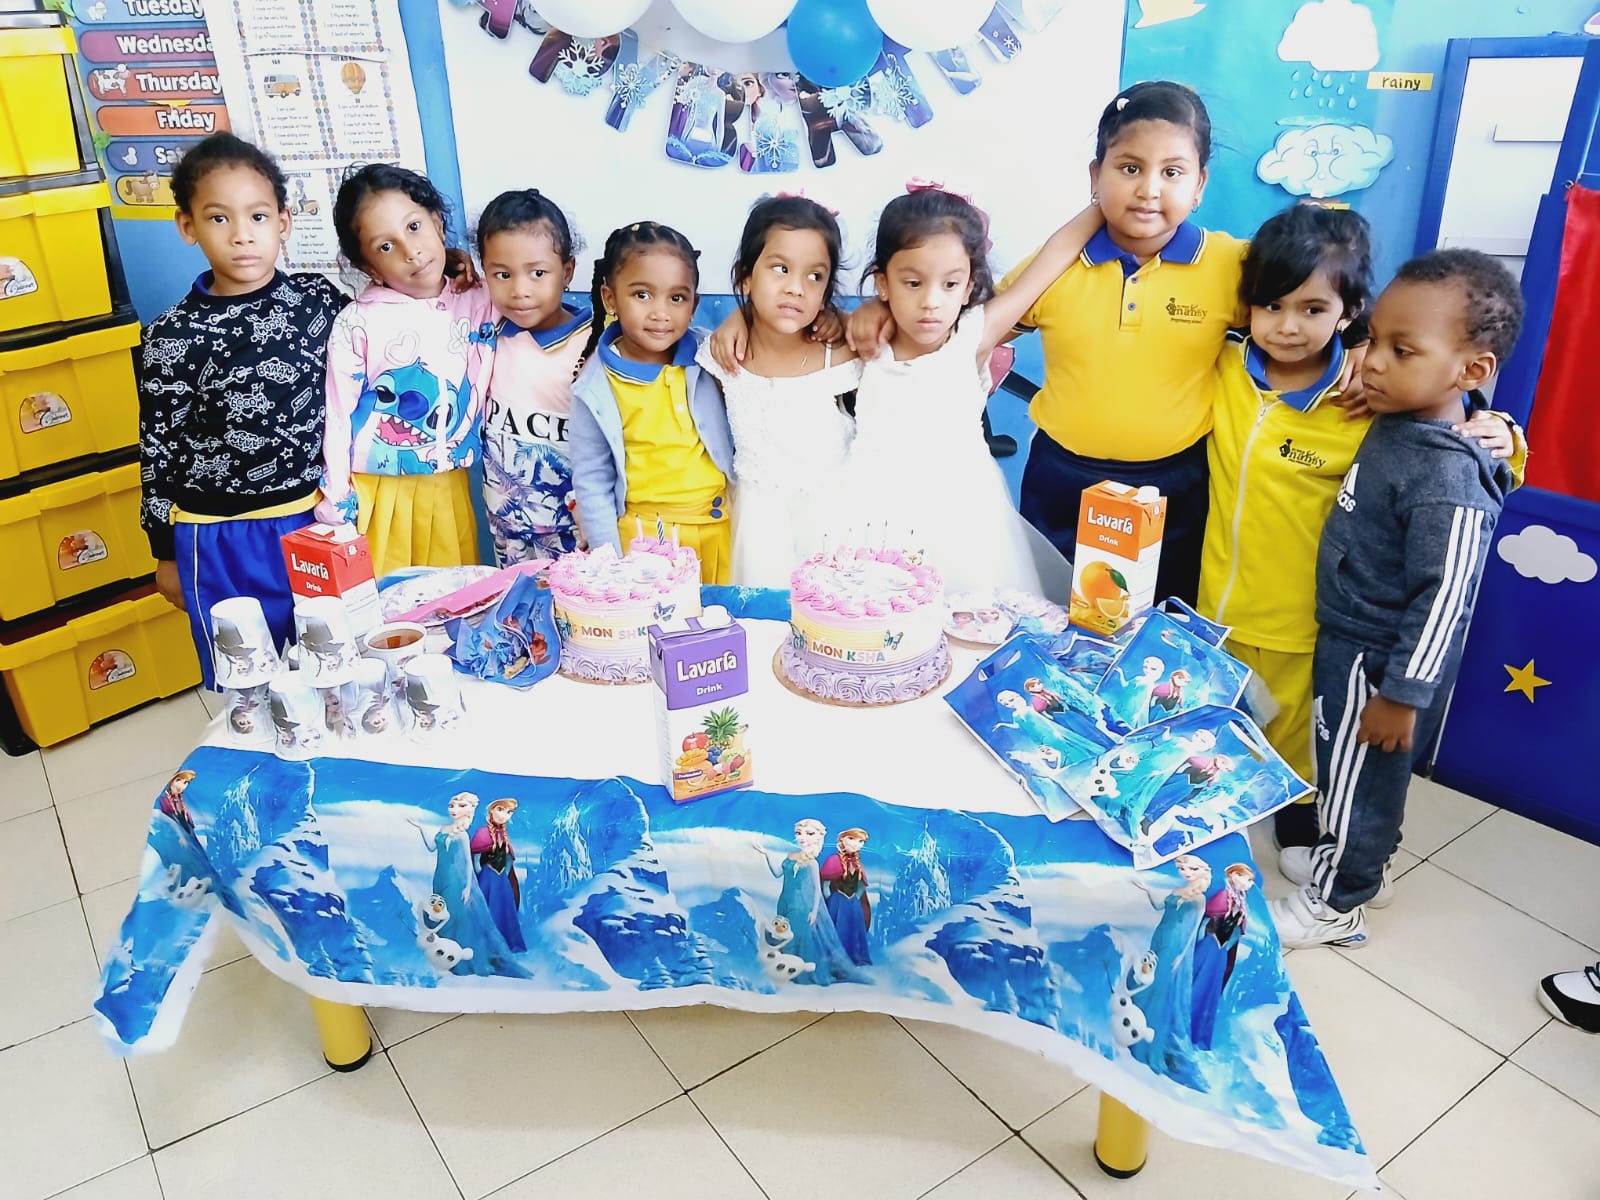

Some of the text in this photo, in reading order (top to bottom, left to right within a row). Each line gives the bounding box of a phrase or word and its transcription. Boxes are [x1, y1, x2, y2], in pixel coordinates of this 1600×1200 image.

[124, 0, 204, 18] Tuesday
[115, 32, 214, 54] Wednesda
[135, 71, 222, 95] Thursday
[1381, 76, 1422, 91] rainy
[1098, 534, 1119, 547] Drink
[305, 581, 323, 593] Drink
[581, 626, 614, 639] MON
[811, 641, 886, 663] MON KSHA
[696, 681, 723, 696] Drink
